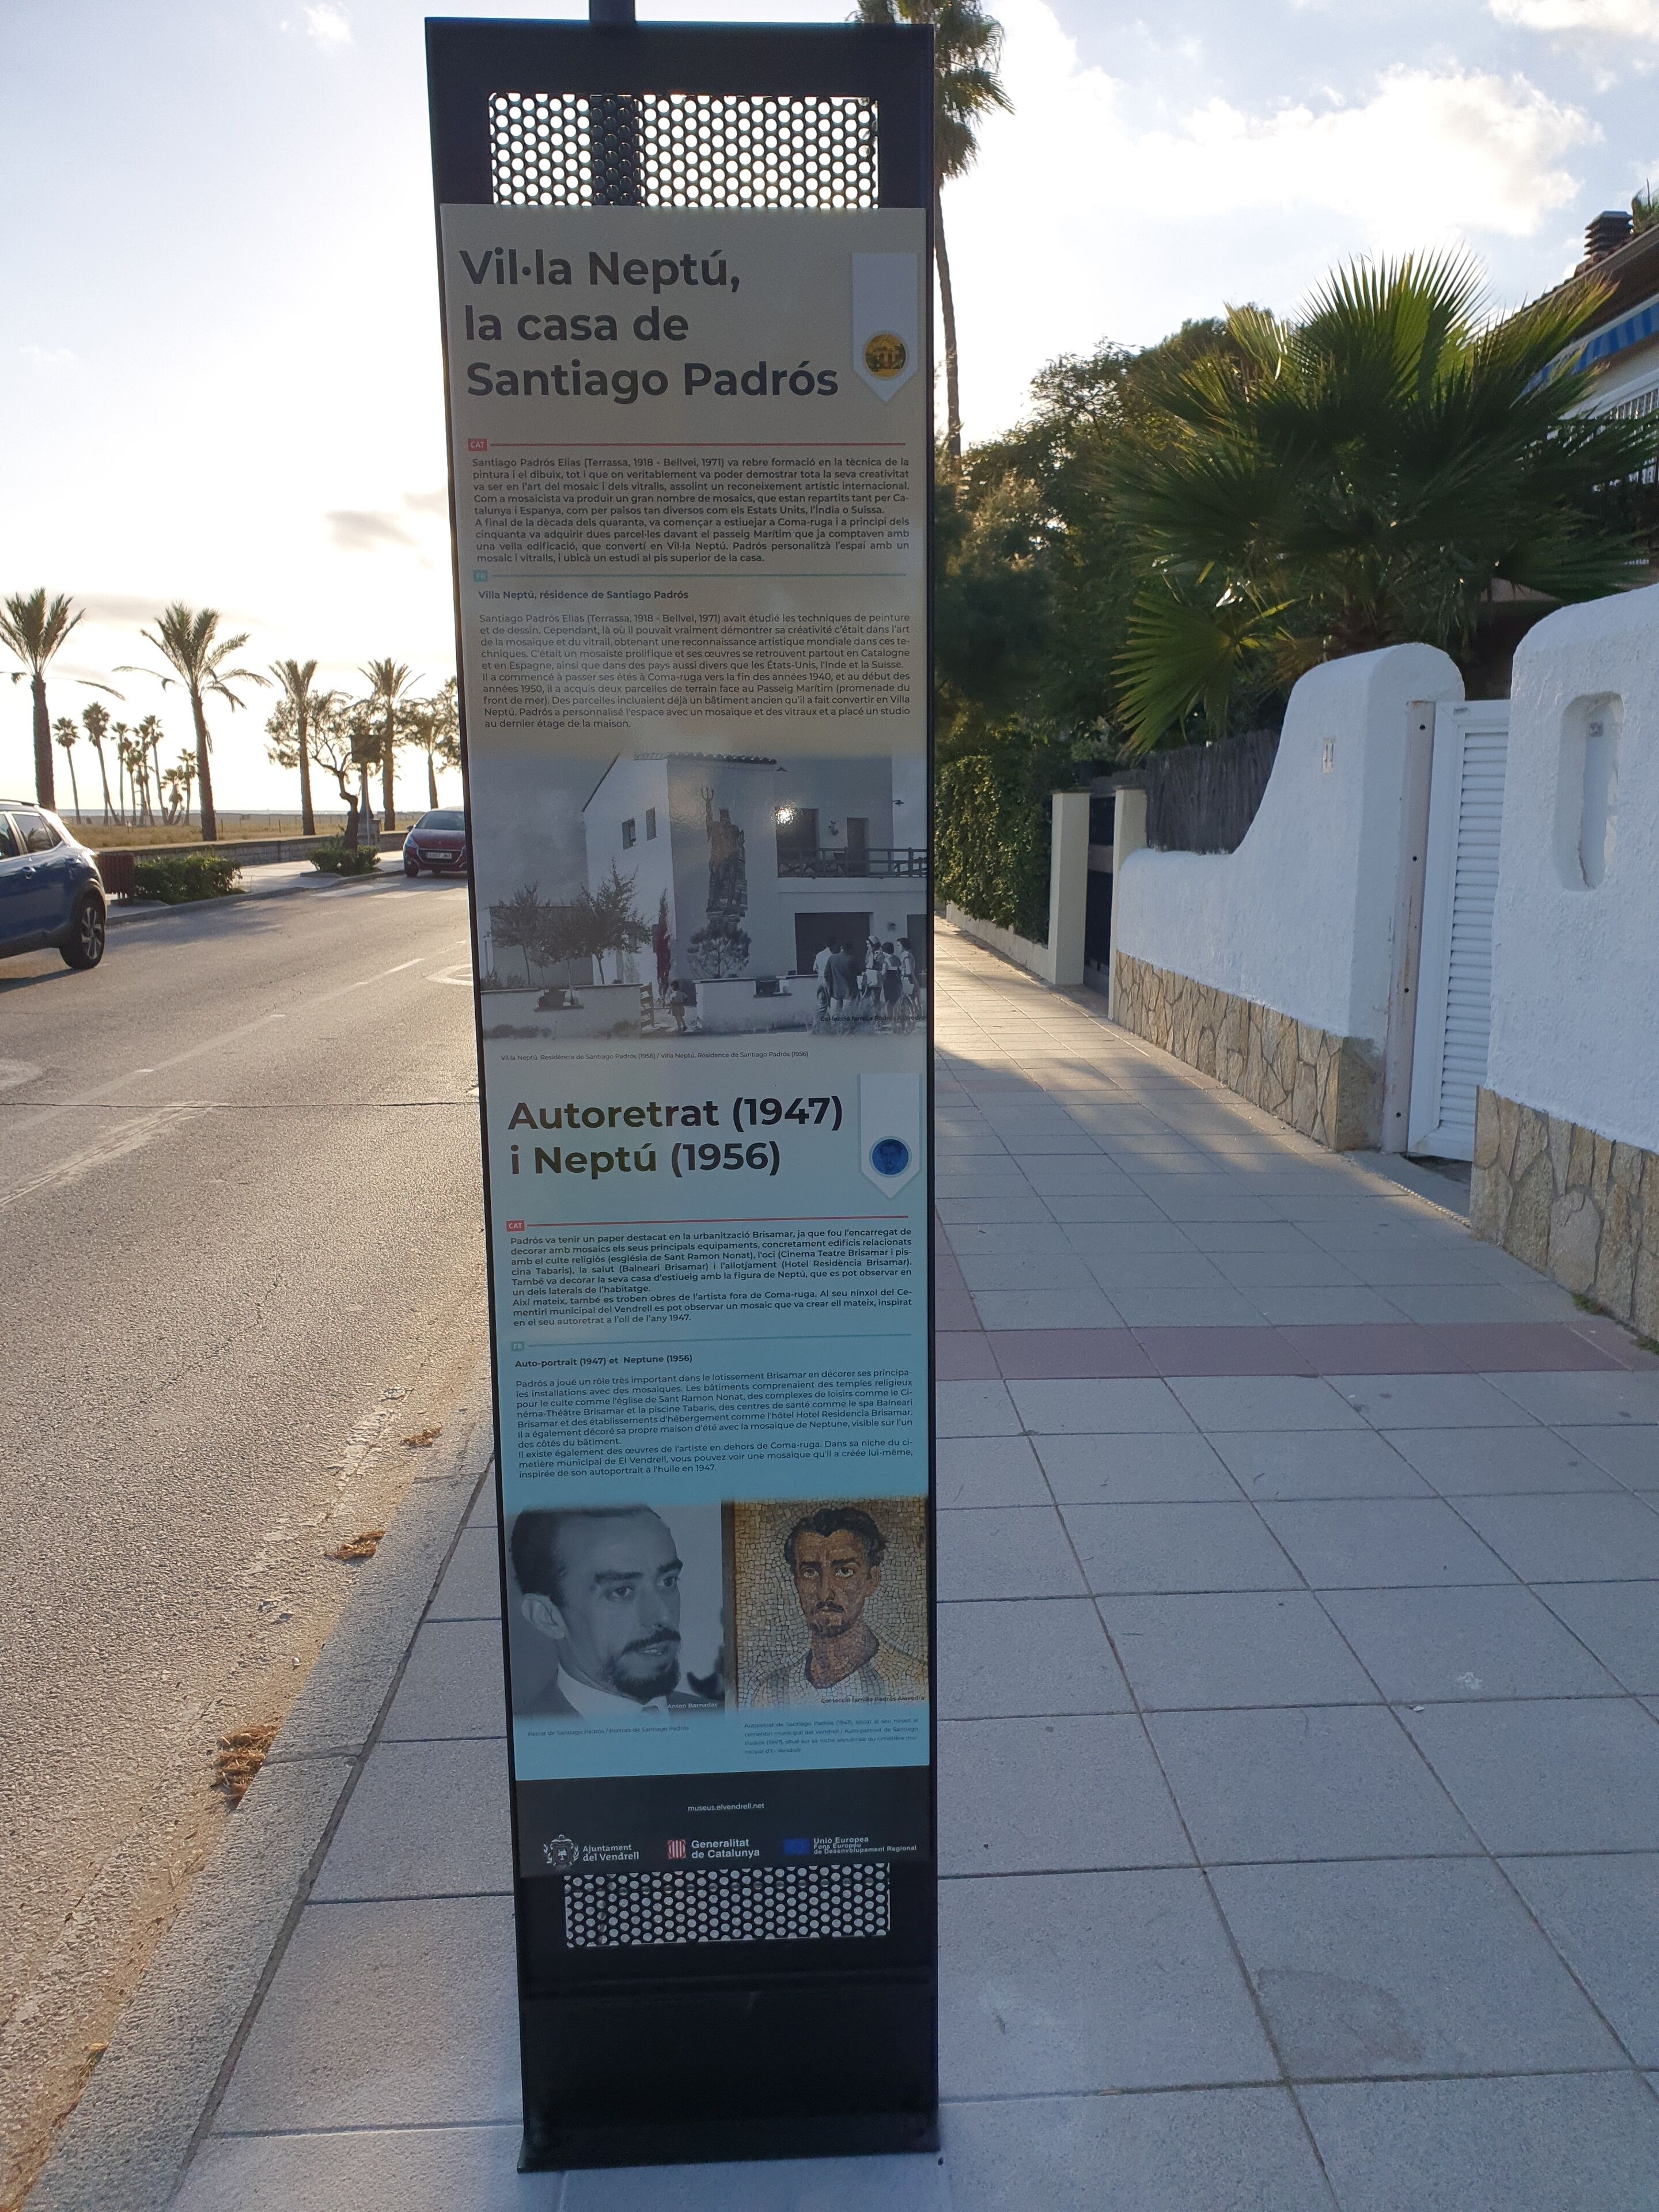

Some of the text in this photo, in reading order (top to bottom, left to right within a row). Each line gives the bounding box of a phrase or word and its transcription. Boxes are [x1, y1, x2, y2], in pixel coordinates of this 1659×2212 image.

[460, 247, 739, 294] Vil·la Neptú,
[465, 305, 688, 340] la casa de
[467, 359, 838, 404] Santiago Padrós
[470, 441, 484, 449] CAT
[475, 529, 526, 540] cinquanta
[544, 529, 583, 540] adquirir
[586, 529, 611, 538] dues
[663, 529, 698, 538] davant
[700, 529, 709, 538] el
[713, 529, 750, 540] passeig
[753, 529, 791, 538] Marítim
[794, 531, 814, 540] que
[816, 529, 825, 540] ja
[828, 530, 884, 540] comptaven
[887, 529, 910, 537] amb
[499, 541, 522, 550] vella
[527, 541, 578, 551] edificació,
[581, 543, 601, 552] que
[605, 541, 646, 550] convertí
[695, 541, 728, 551] Neptú.
[733, 541, 767, 550] Padrós
[771, 540, 831, 552] personalitzà
[869, 541, 892, 550] amb
[478, 589, 689, 601] Villa Neptú, résidence de Santiago Padrós
[480, 649, 528, 660] chniques.
[625, 649, 672, 659] prolifique
[808, 649, 844, 659] partout
[861, 648, 910, 658] Catalogne
[508, 1096, 842, 1132] Autoretrat (1947)
[511, 1141, 779, 1180] i Neptú (1956)
[510, 1247, 547, 1255] decorar
[548, 1245, 570, 1254] amb
[572, 1244, 611, 1253] mosaics
[612, 1244, 626, 1252] els
[650, 1242, 695, 1252] principals
[697, 1240, 760, 1251] equipaments,
[762, 1240, 826, 1248] concretament
[828, 1238, 861, 1247] edificis
[862, 1237, 912, 1247] relacionats
[511, 1267, 531, 1275] cina
[535, 1266, 574, 1276] Tabaris),
[592, 1265, 614, 1273] salut
[619, 1263, 660, 1274] (Balneari
[664, 1262, 709, 1272] Brisamar)
[781, 1259, 808, 1270] (Hotel
[813, 1258, 862, 1267] Residència
[866, 1257, 912, 1268] Brisamar).
[514, 1357, 577, 1369] Auto-portrait
[579, 1357, 606, 1366] (1947)
[623, 1355, 664, 1365] Neptune
[666, 1354, 692, 1364] (1956)
[516, 1390, 529, 1398] les
[531, 1388, 587, 1397] installations
[752, 1380, 815, 1391] comprenaient
[817, 1380, 834, 1388] des
[836, 1379, 872, 1389] temples
[874, 1377, 912, 1388] religieux
[584, 1406, 624, 1415] Brisamar
[638, 1406, 646, 1414] la
[648, 1404, 680, 1414] piscine
[682, 1403, 716, 1413] Tabaris,
[718, 1403, 734, 1411] des
[785, 1400, 810, 1409] santé
[858, 1400, 874, 1408] spa
[877, 1398, 912, 1407] Balneari
[687, 1802, 765, 1812] museus.elvendrell.net
[582, 1844, 632, 1855] Ajuntament
[692, 1839, 749, 1849] Generalitat
[824, 1846, 884, 1854] Desenvolupament
[582, 1851, 639, 1862] del Vendrell
[692, 1845, 759, 1858] de Catalunya
